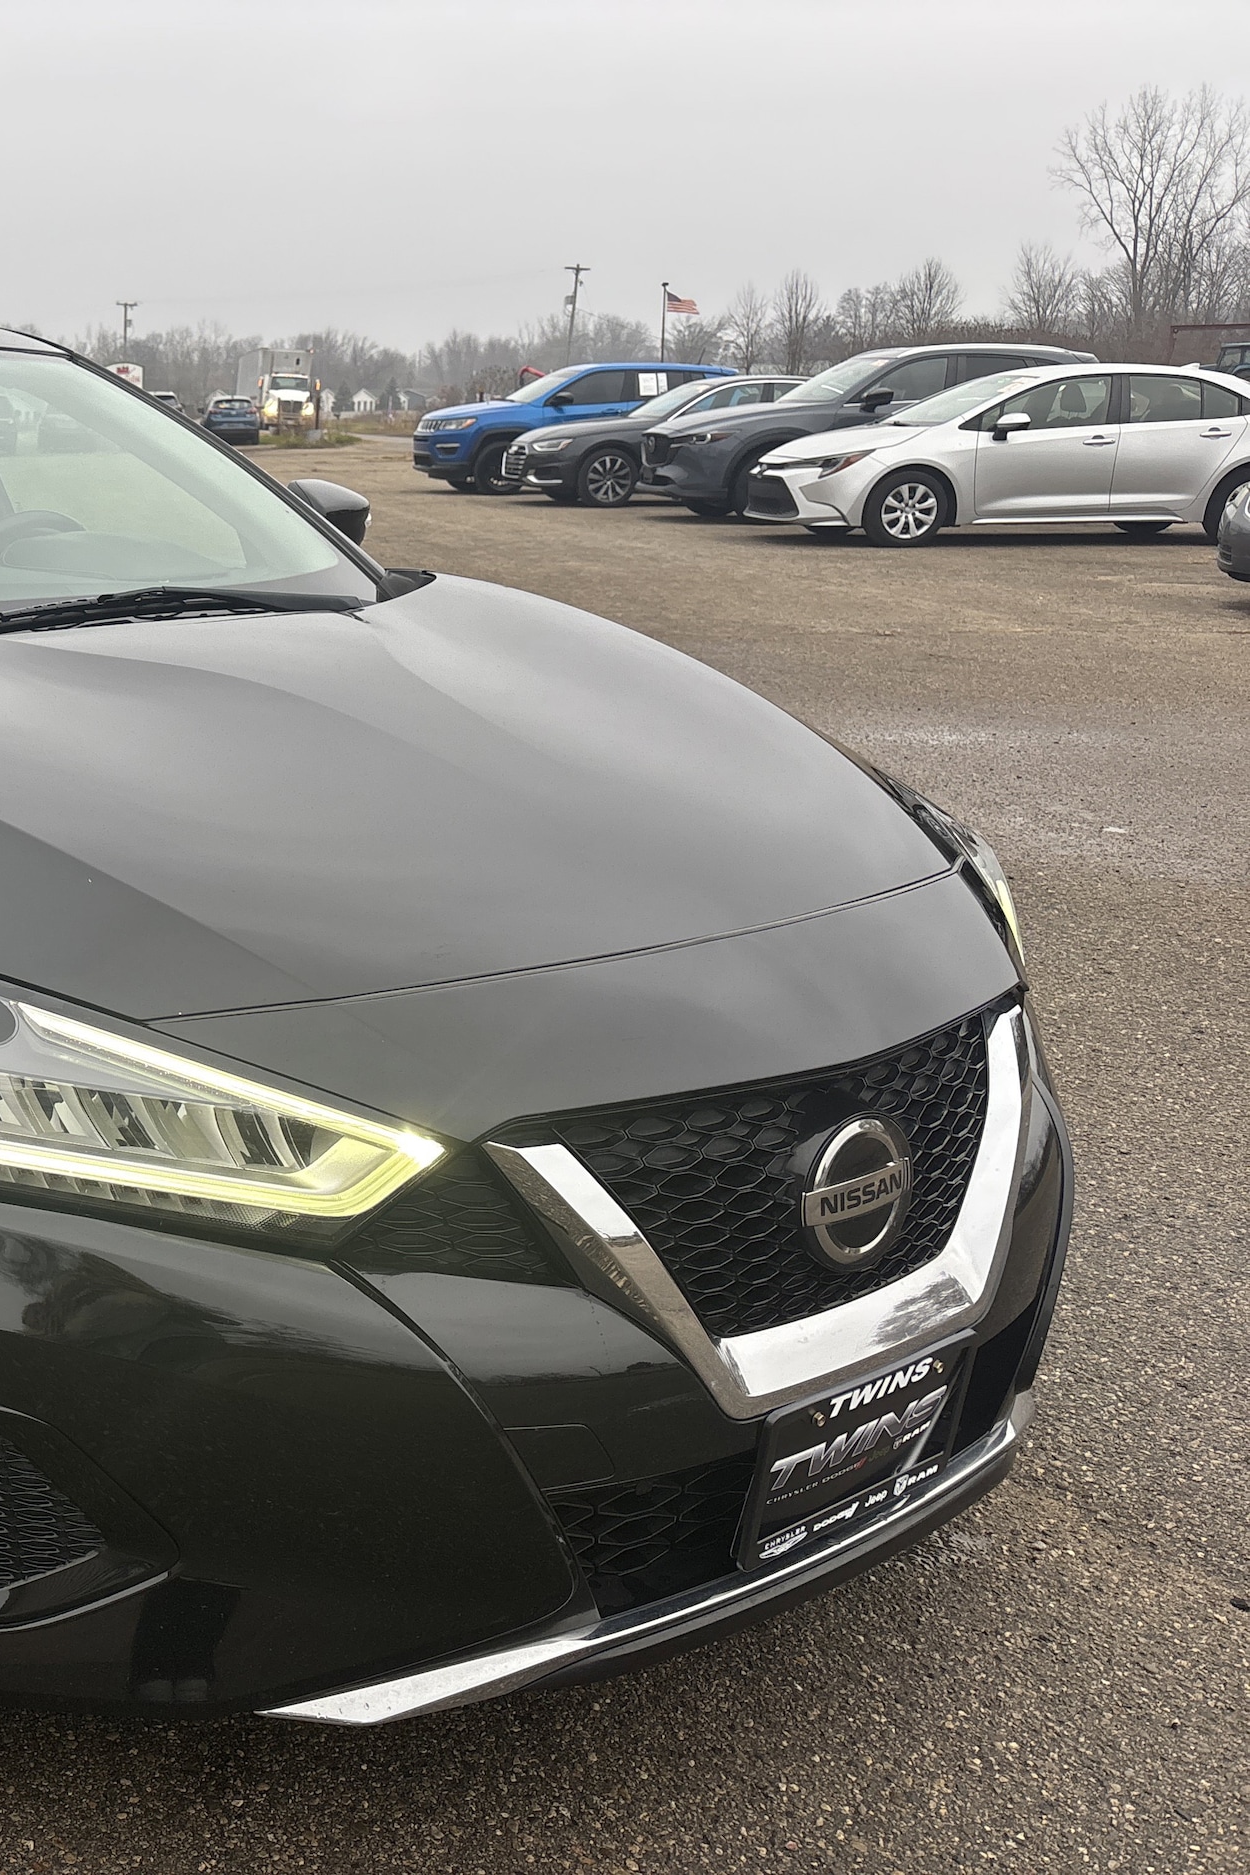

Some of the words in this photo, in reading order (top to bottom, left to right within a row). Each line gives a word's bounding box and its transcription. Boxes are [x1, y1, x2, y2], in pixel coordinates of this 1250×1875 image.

[820, 1169, 902, 1217] NISSAN
[829, 1356, 933, 1419] TWINS
[766, 1481, 819, 1505] CHRYSLER
[902, 1420, 931, 1443] RAM
[769, 1385, 948, 1491] TWINS
[764, 1525, 806, 1550] CHRYSLER
[864, 1489, 888, 1508] Jeep
[907, 1464, 939, 1487] RAM
